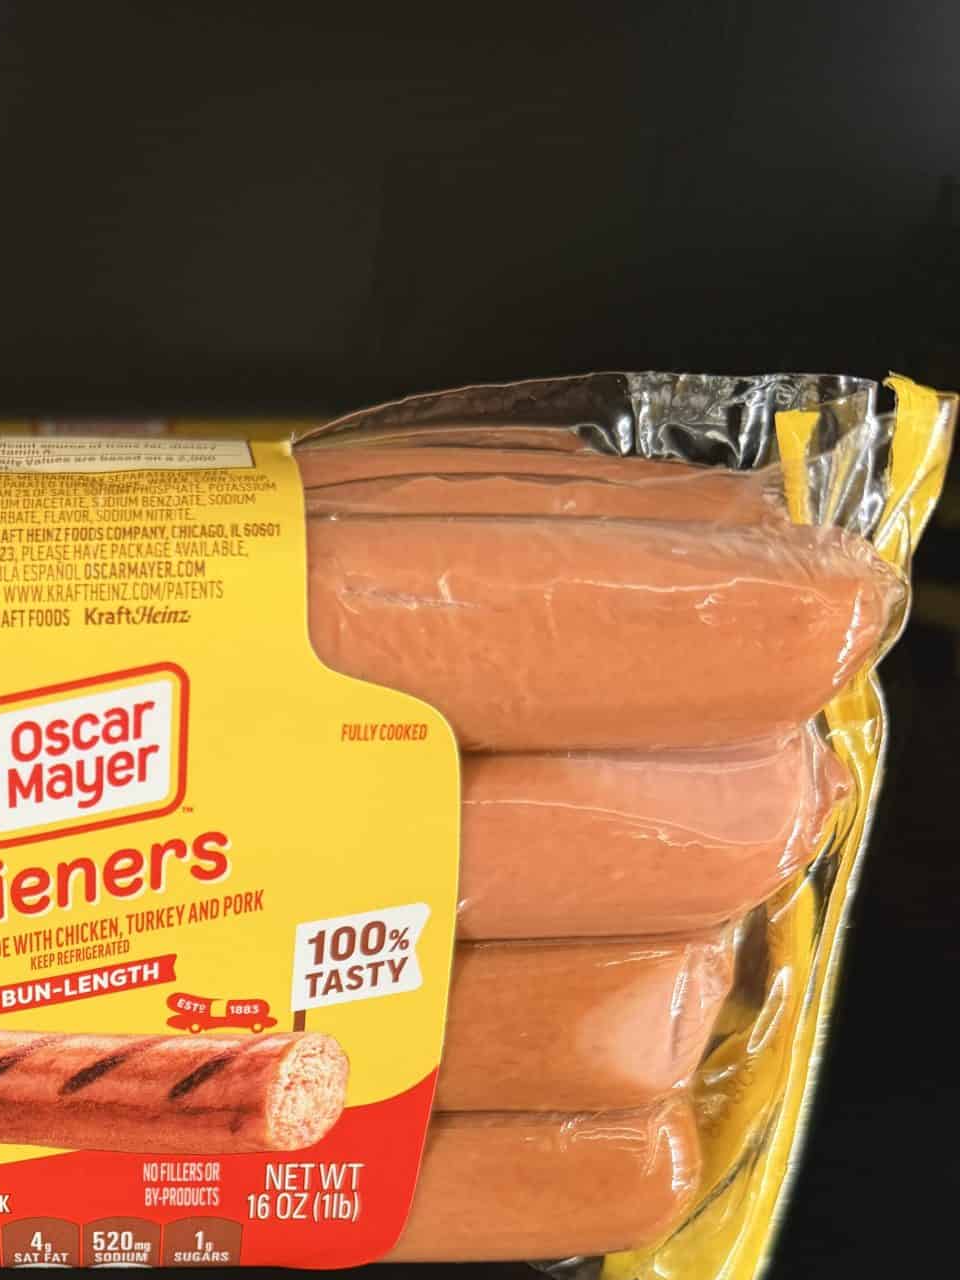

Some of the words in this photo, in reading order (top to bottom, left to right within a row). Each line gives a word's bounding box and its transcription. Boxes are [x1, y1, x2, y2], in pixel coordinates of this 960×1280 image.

[44, 510, 91, 523] FLAVOR,
[96, 509, 143, 522] SODIUM
[144, 508, 196, 521] NITRITE.
[26, 527, 61, 543] HEINZ
[64, 526, 104, 542] FOODS
[106, 525, 169, 541] COMPANY,
[171, 524, 228, 540] CHICAGO,
[230, 524, 241, 538] IL
[22, 544, 71, 562] PLEASE
[72, 543, 110, 560] HAVE
[111, 541, 170, 559] PACKAGE
[175, 539, 249, 557] AVAILABLE,
[23, 560, 81, 582] ESPAÑOL
[84, 559, 206, 580] OSCARMAYER.COM
[3, 580, 224, 604] WWW.KRAFTHEINZ.COM/PATENTS
[28, 608, 71, 628] FOODS
[10, 700, 156, 763] Oscar
[340, 723, 378, 742] FULLY
[379, 723, 428, 741] COOKED
[7, 744, 160, 809] Mayer
[12, 930, 53, 960] WITH
[55, 917, 124, 949] CHICKEN,
[126, 905, 186, 936] TURKEY
[188, 897, 221, 924] AND
[223, 889, 265, 917] PORK
[307, 920, 410, 966] 100%
[30, 951, 55, 971] KEEP
[57, 939, 131, 966] REFRIGERATED
[0, 962, 160, 1008] BUN-LENGTH
[305, 956, 409, 999] TASTY
[143, 1163, 159, 1182] NO
[160, 1162, 203, 1182] FILLERS
[204, 1162, 221, 1181] OR
[264, 1163, 315, 1191] NET
[317, 1162, 365, 1191] WT
[144, 1186, 220, 1207] BY-PRODUCTS
[247, 1194, 270, 1220] 16
[275, 1194, 308, 1220] OZ
[312, 1192, 360, 1223] (1lb)
[30, 1231, 52, 1253] 4g
[92, 1231, 152, 1253] 520mg
[194, 1231, 214, 1252] 1g
[14, 1252, 41, 1263] SAT
[44, 1252, 69, 1263] FAT
[94, 1252, 148, 1263] SODIUM
[174, 1252, 229, 1263] SUGARS
